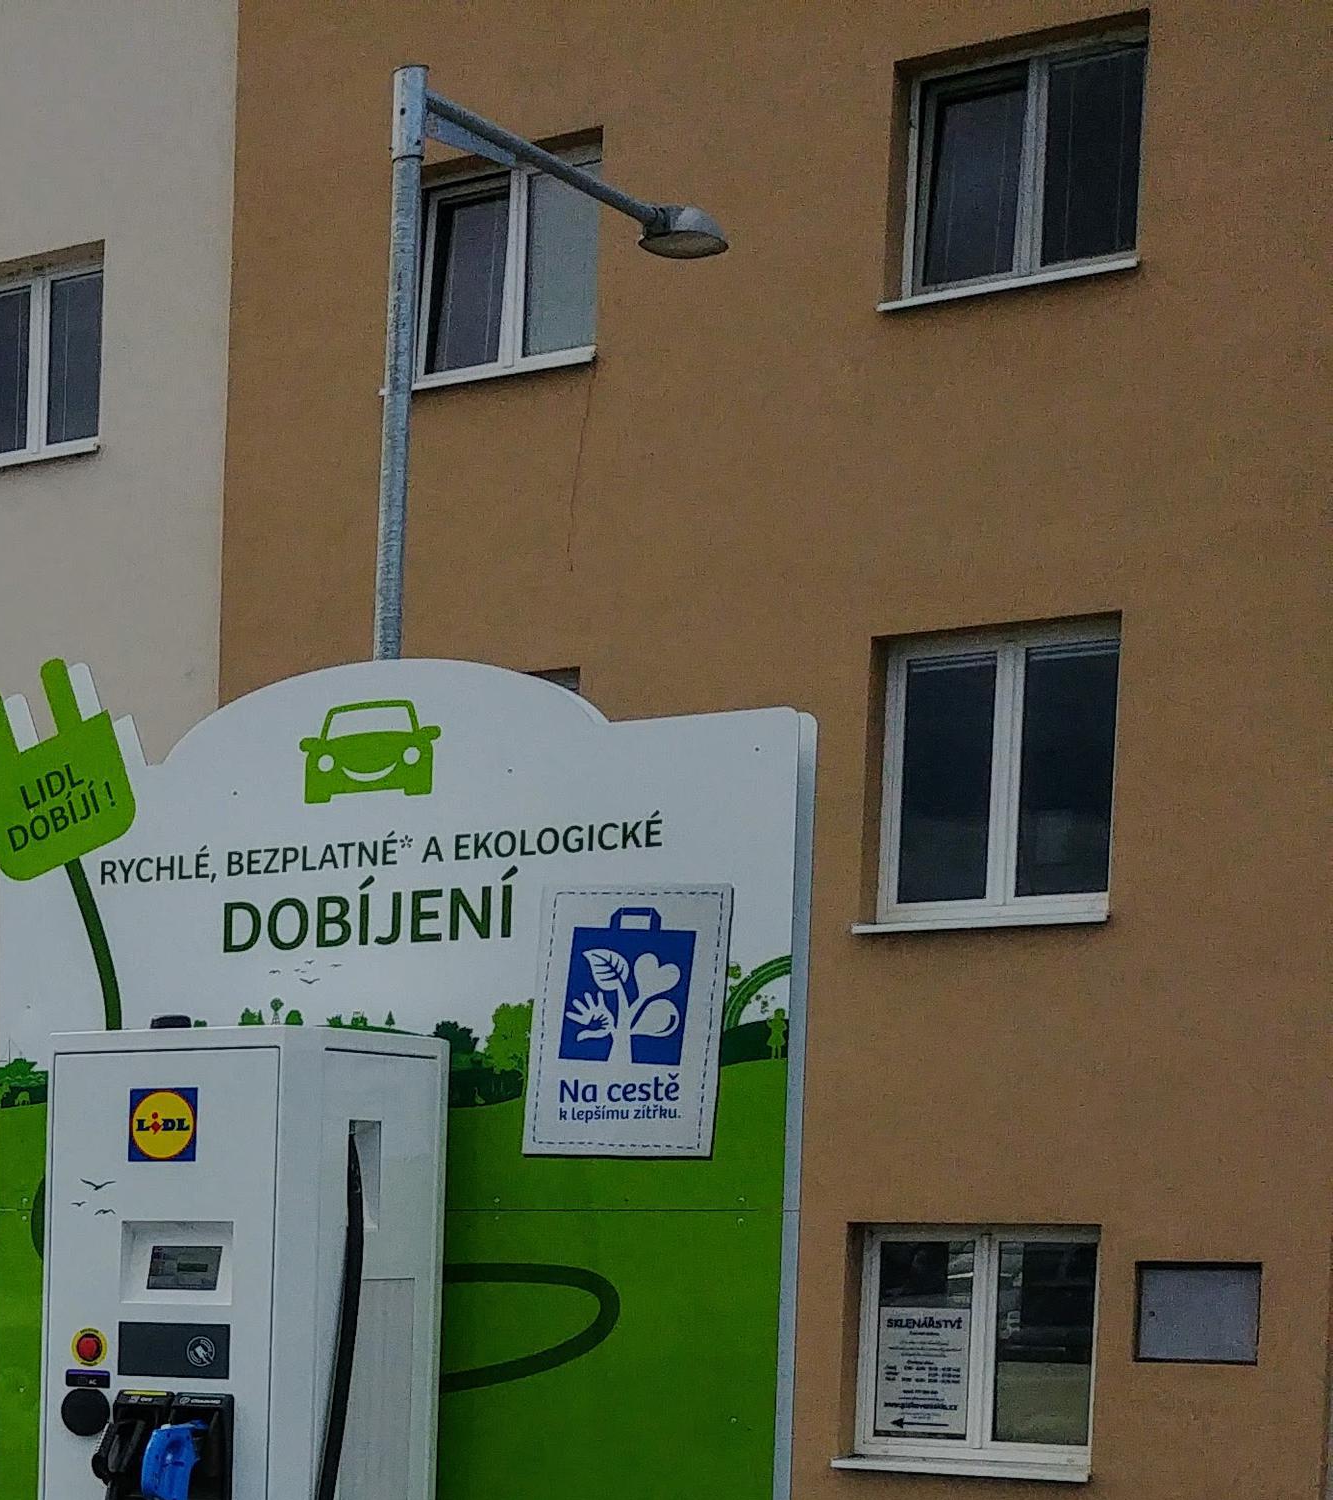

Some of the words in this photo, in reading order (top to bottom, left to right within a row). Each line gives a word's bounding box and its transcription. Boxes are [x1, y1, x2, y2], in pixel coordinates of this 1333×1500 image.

[7, 780, 101, 853] DOBÍJÍ
[19, 763, 85, 811] LIDL
[99, 844, 217, 885] RYCHLÉ,
[421, 835, 445, 864] A
[453, 809, 664, 862] EKOLOGICKÉ
[222, 864, 519, 954] DOBÍJENÍ
[558, 1078, 598, 1104] Na
[606, 1071, 681, 1103] cestě
[558, 1106, 568, 1121] k
[571, 1104, 630, 1124] lepšímu
[632, 1103, 682, 1120] zítřku.
